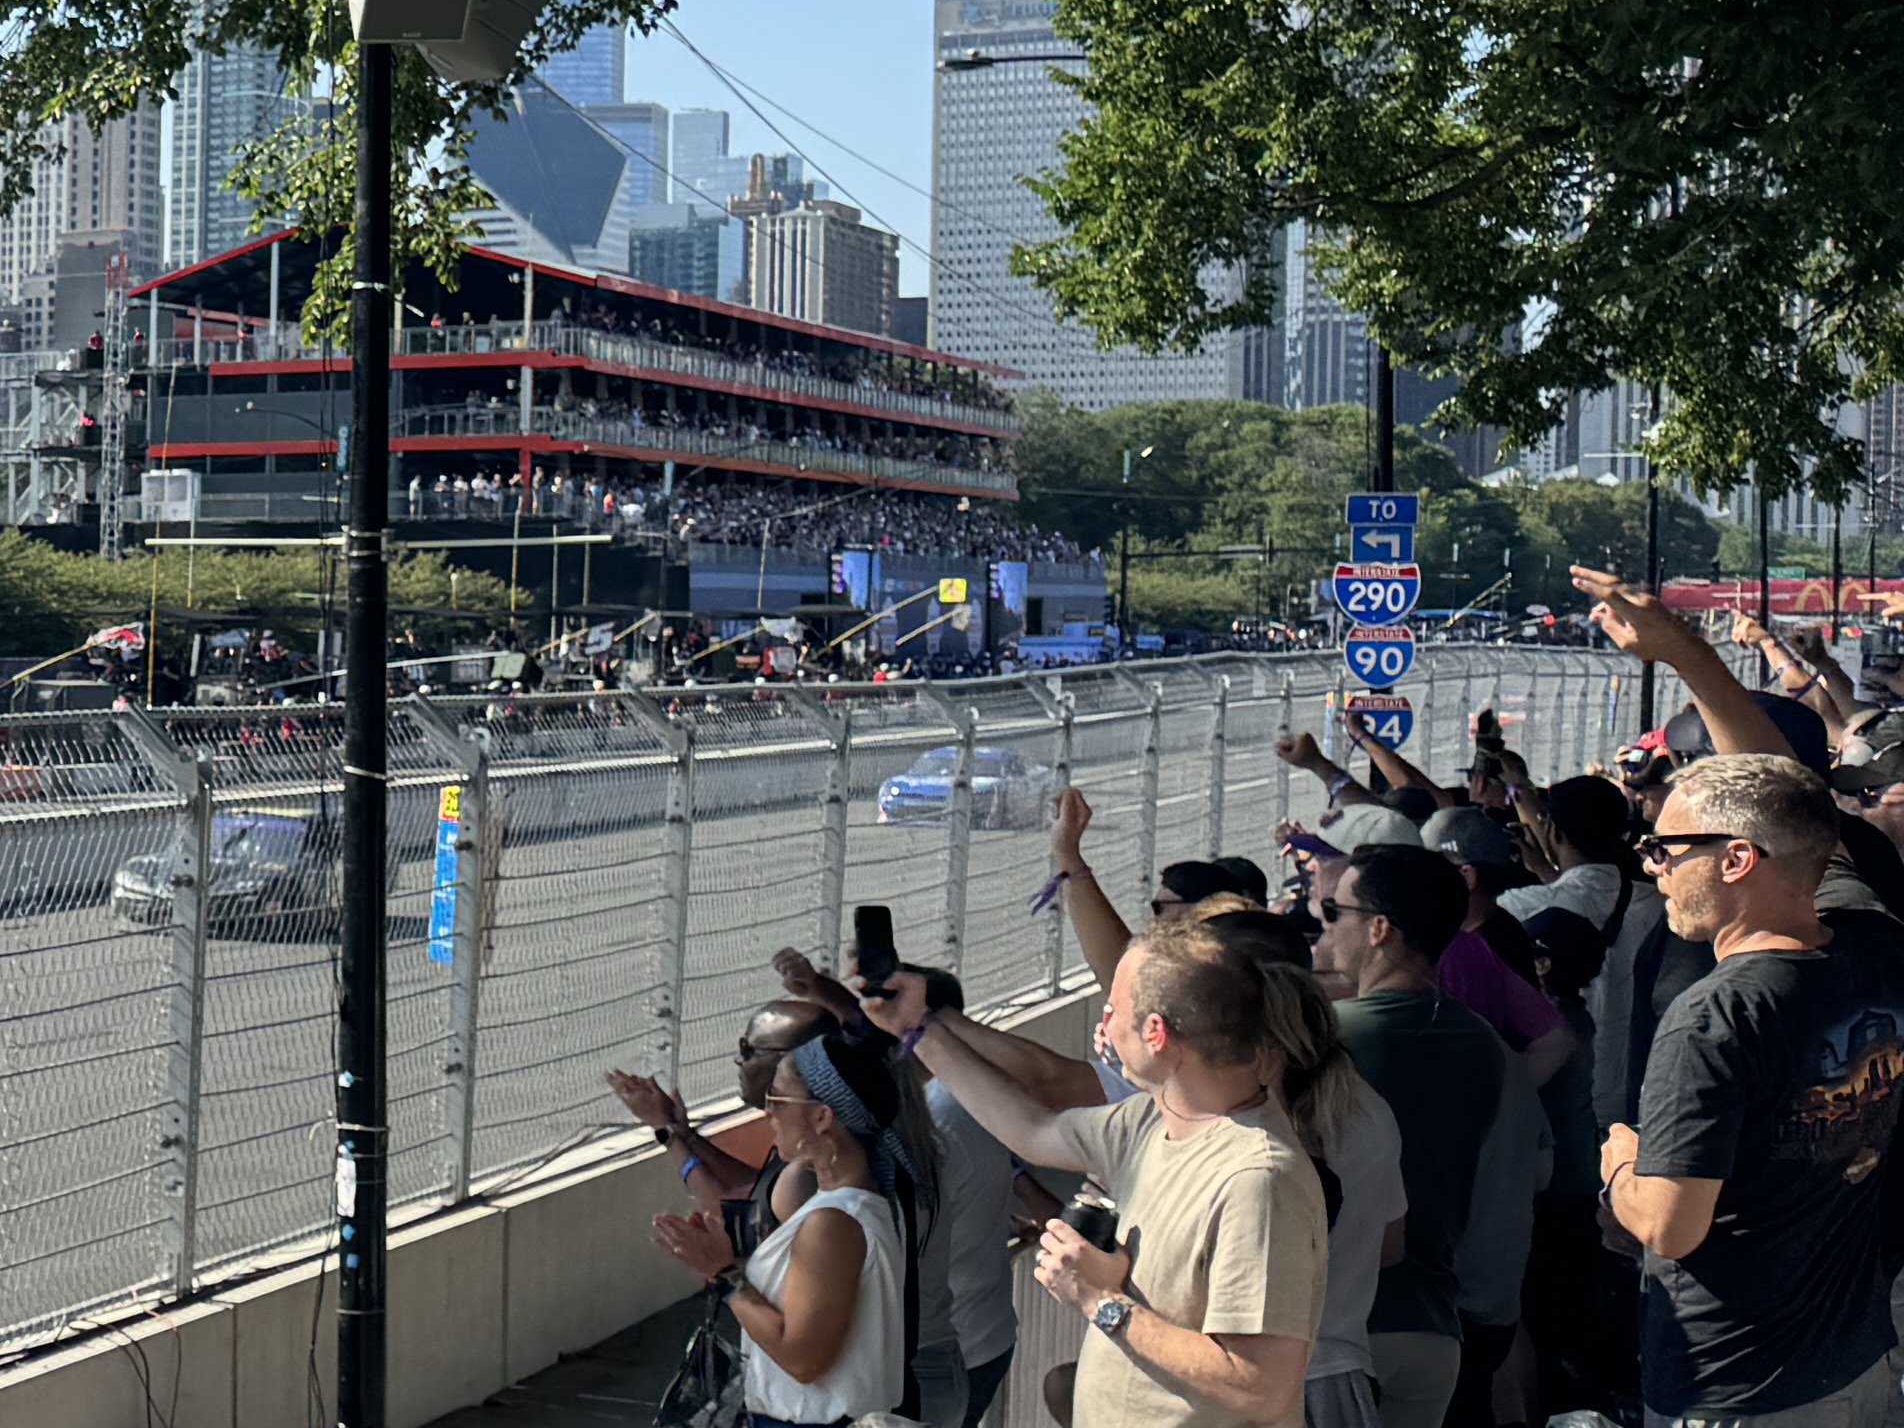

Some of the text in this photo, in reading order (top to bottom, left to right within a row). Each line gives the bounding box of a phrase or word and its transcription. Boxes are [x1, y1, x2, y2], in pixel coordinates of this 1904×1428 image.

[1369, 499, 1397, 520] TO
[1352, 567, 1402, 578] INTERSTATE
[1348, 581, 1406, 613] 290
[1355, 628, 1404, 639] INTERSTATE
[1354, 646, 1404, 676] 90
[1354, 698, 1404, 709] INTERSTATE
